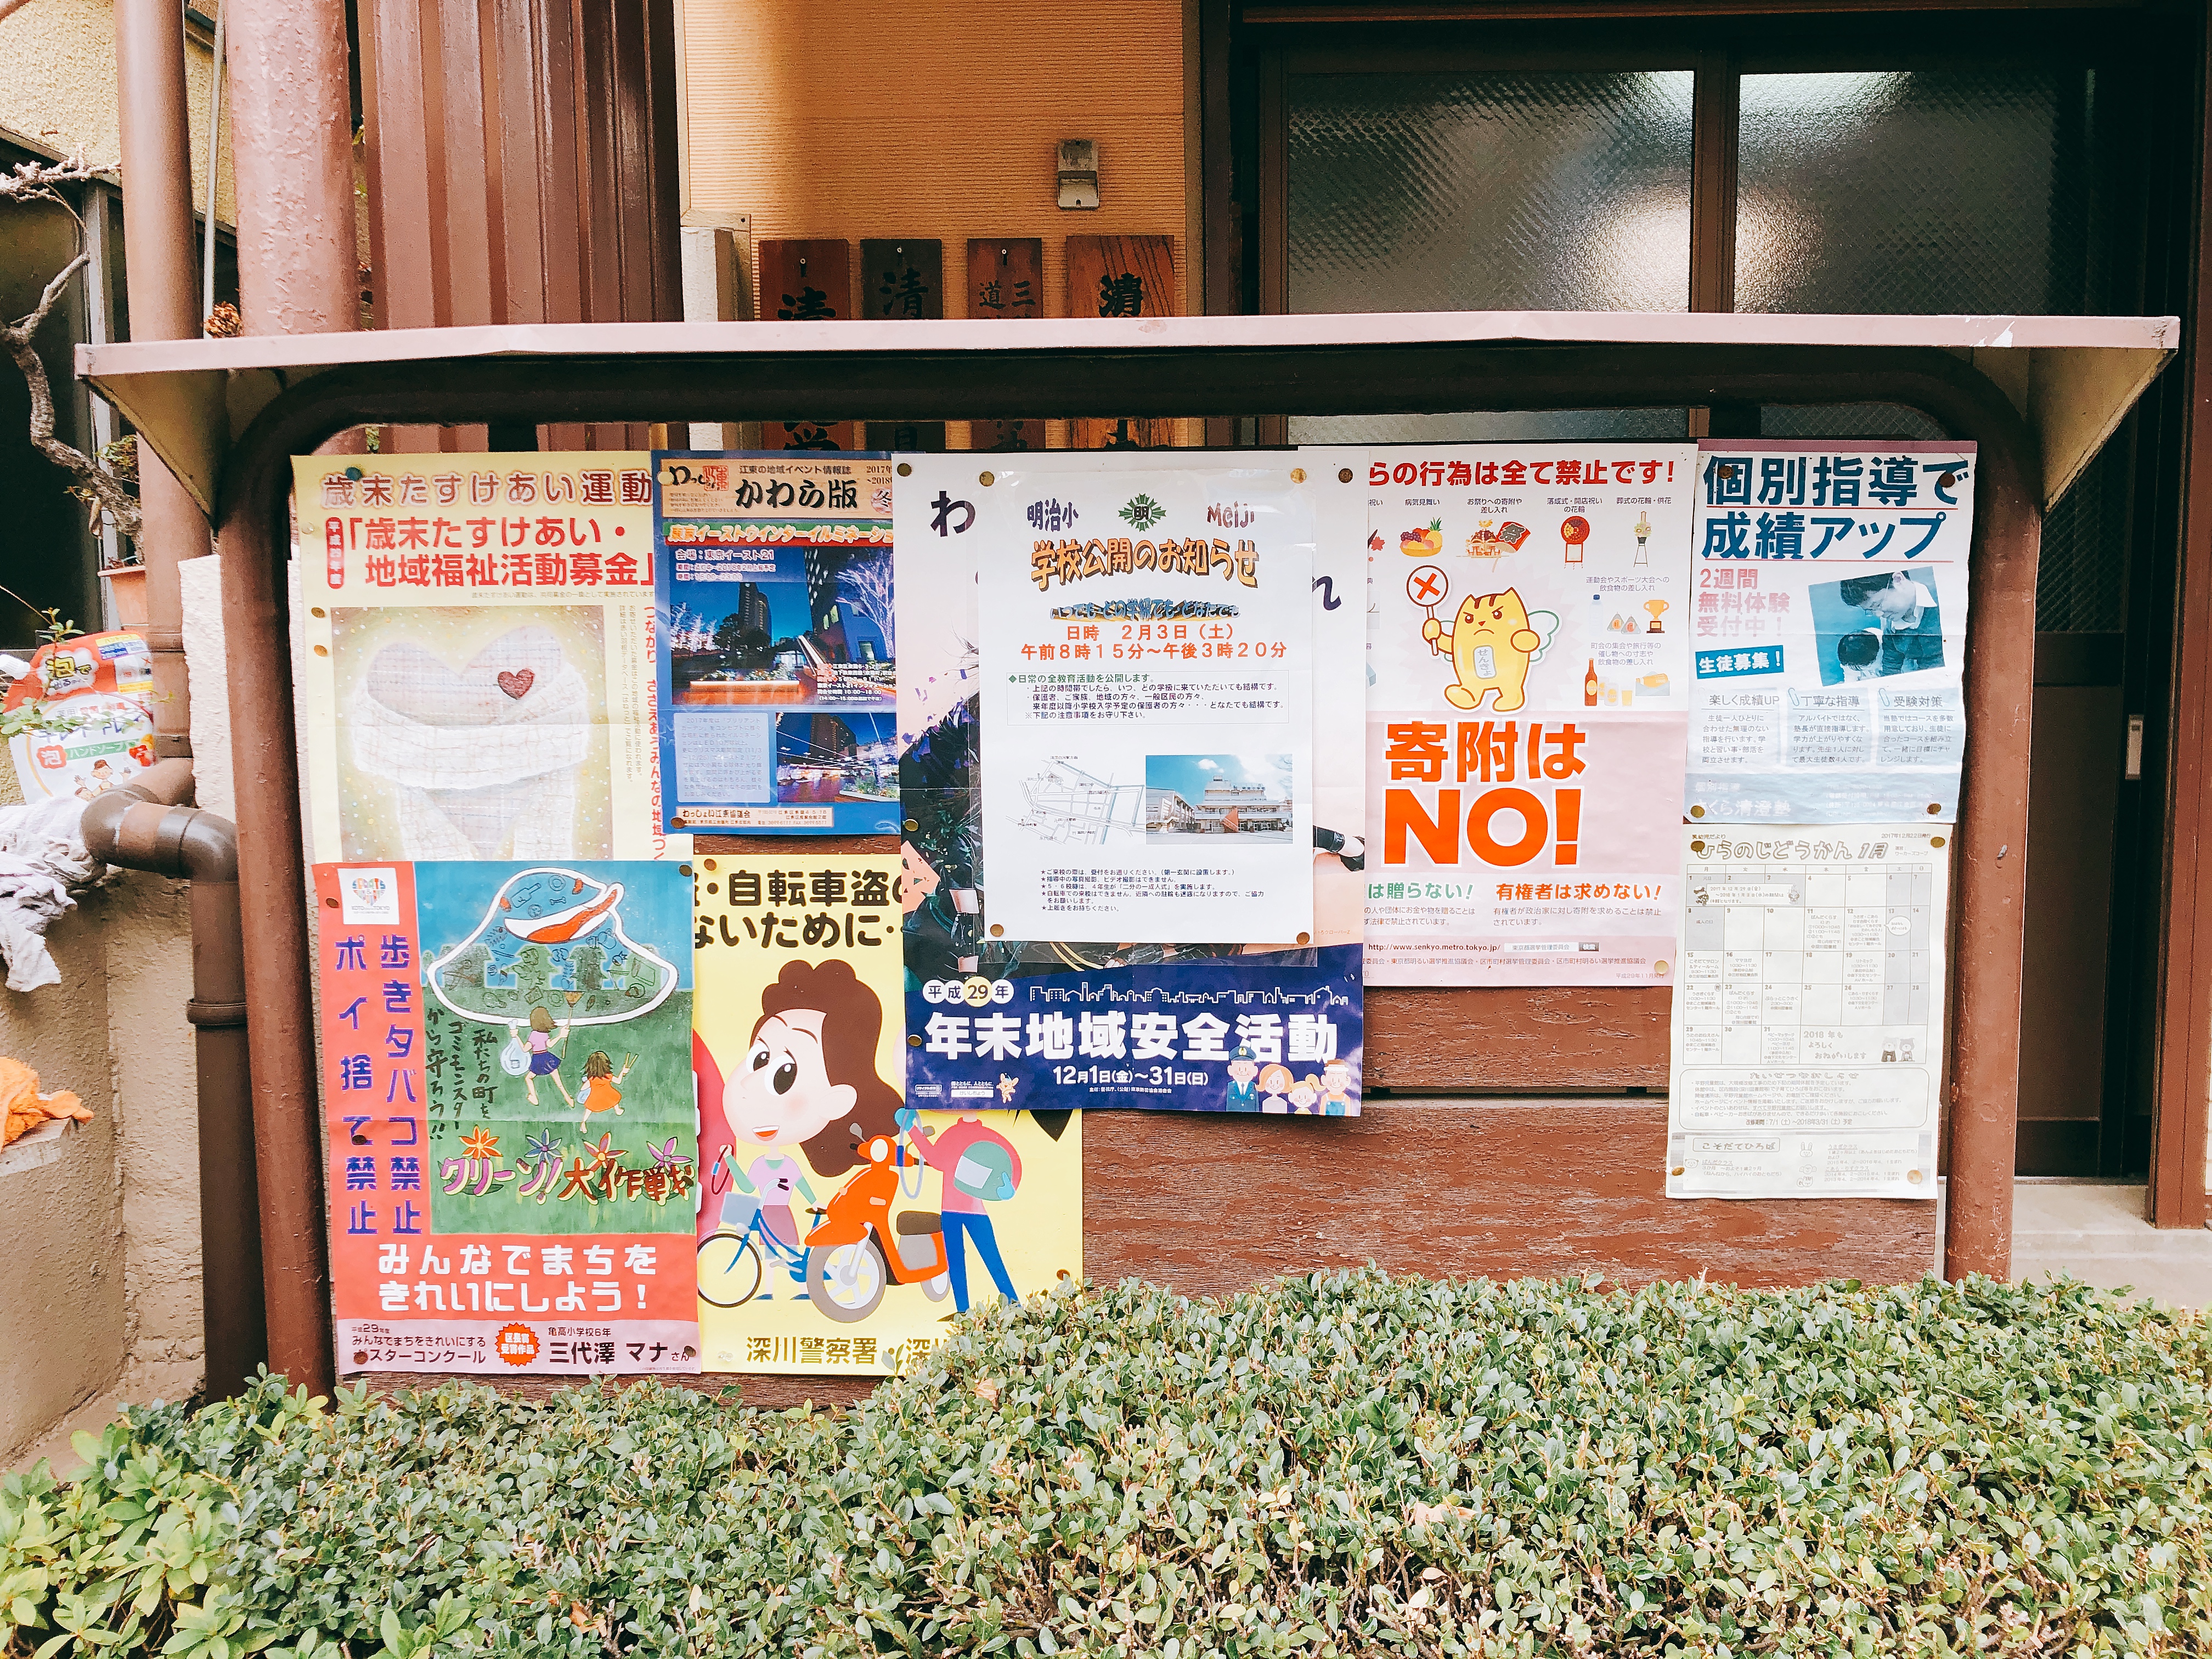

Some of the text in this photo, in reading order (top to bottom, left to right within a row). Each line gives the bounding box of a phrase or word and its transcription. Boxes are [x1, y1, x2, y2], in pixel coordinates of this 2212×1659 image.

[739, 465, 851, 475] 江東の地域イベント情報誌
[1368, 459, 1675, 487] らの行為は全て禁止です！
[1702, 455, 1970, 507] 個別指導で
[324, 472, 651, 505] 歳末たすけあい運動
[735, 478, 858, 509] かわら版
[1405, 498, 1440, 506] 病気見舞い
[1467, 497, 1522, 506] お祭りへの寄附や
[1547, 497, 1602, 506] 落成式・開店祝い
[1616, 496, 1672, 505] 葬式の花輪・供花
[930, 490, 977, 538] わ
[1028, 499, 1079, 531] 明治小
[1133, 505, 1149, 521] 明
[1207, 500, 1255, 529] Meiji
[1480, 506, 1508, 515] 差し入れ
[1564, 505, 1585, 514] の花輪
[1701, 511, 1947, 560] 成績アップ
[365, 552, 654, 586] 地域福祉活動募金」
[1029, 537, 1260, 591] 学校公開のお知らせ
[1586, 575, 1670, 585] 運動会やスポーツ大会への
[1700, 568, 1758, 590] 2週間
[1600, 584, 1656, 592] 飲食物の差し入れ
[1697, 593, 1790, 614] 無料体験
[1067, 625, 1099, 641] 日時
[1590, 641, 1661, 650] 町会の集会や旅行等の
[1598, 650, 1654, 658] 催し物への寸志や
[1477, 648, 1492, 677] せんきょ
[1598, 658, 1654, 666] 飲食物の差し入れ
[1018, 673, 1155, 684] 日常の全教育活動を公開します。
[1708, 695, 1780, 707] 楽しく成績UP
[1801, 695, 1860, 707] 丁寧な指導
[1893, 696, 1943, 708] 受験対策
[1708, 714, 1764, 723] 生徒一人ひとりに
[1798, 714, 1860, 723] アルバイトではなく、
[1883, 714, 1954, 723] 当塾ではコースを多数
[1702, 725, 1769, 733] 合わせた無理のない
[1793, 725, 1870, 733] 塾長が直接指導します。
[1884, 725, 1951, 733] 用意しており、生徒に
[1702, 735, 1766, 744] 指導を行います。学
[1793, 735, 1863, 744] 学力が上がりやすくな
[1385, 720, 1587, 783] 寄附は
[1702, 746, 1764, 754] 校と習い事・部活を
[41, 750, 62, 766] 泡
[1702, 757, 1748, 765] 両立させます。
[1880, 756, 1925, 764] レンジします。
[1384, 787, 1582, 867] NO!
[1858, 842, 1889, 860] 1月
[1364, 906, 1475, 915] の人や団体にお金や物を贈ることは
[1493, 906, 1661, 916] 有権者が政治家に対し寄附を求めることは禁止
[1493, 918, 1543, 927] されています。
[1368, 943, 1501, 952] http://www.senkyo.metro.tokyo.jp/
[928, 983, 1011, 1000] 平成29年
[925, 1010, 1338, 1063] 年末地域安全活動
[1815, 1052, 1867, 1060] おねがいします
[448, 1021, 467, 1130] ゴミモンスター
[472, 1029, 499, 1119] 私たちの町を
[1750, 1071, 1859, 1080] たいせつなおしらせ
[335, 935, 378, 1235] ポイ捨て禁止
[380, 934, 422, 1235] 歩きタバコ禁止
[1702, 1142, 1776, 1150] こそだてひろば
[557, 1157, 695, 1206] 大作戦
[379, 1244, 656, 1276] みんなでまちを
[379, 1280, 647, 1313] きれいにしよう！
[548, 1327, 611, 1337] 亀高小学校6年
[352, 1336, 486, 1347] みんなでまちをきれいにする
[504, 1332, 530, 1344] 区長賞
[501, 1344, 535, 1355] 受賞作品
[549, 1341, 614, 1364] 三代澤
[626, 1342, 668, 1362] マナ
[353, 1348, 486, 1364] スターコンクール
